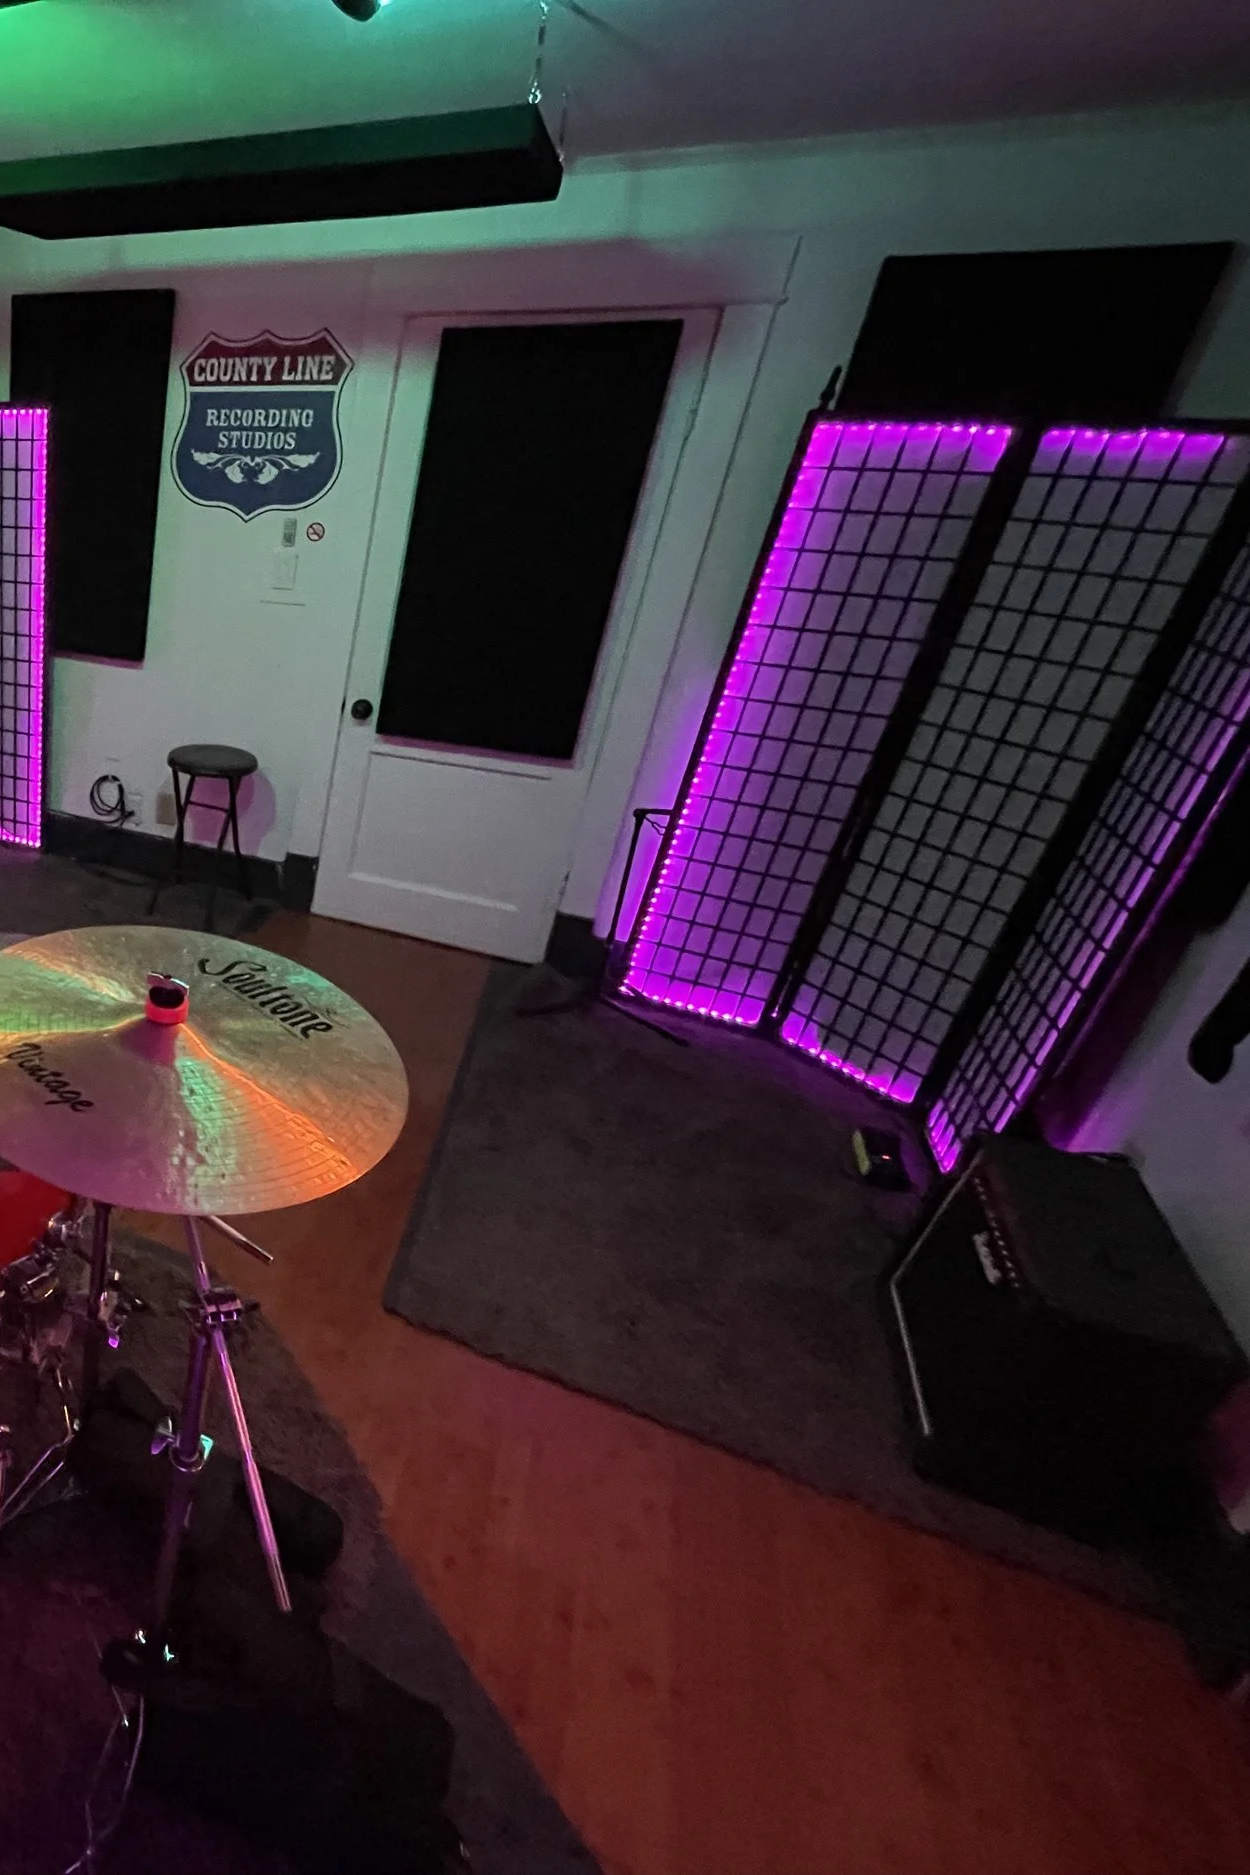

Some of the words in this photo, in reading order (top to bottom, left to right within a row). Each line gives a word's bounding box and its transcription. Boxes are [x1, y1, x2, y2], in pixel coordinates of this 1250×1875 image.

[193, 356, 276, 382] COUNTY
[281, 355, 336, 380] LINE
[206, 408, 314, 427] RECORDING
[217, 431, 296, 449] STUDIOS
[198, 958, 333, 1039] Soultone
[6, 1042, 93, 1112] Vintage
